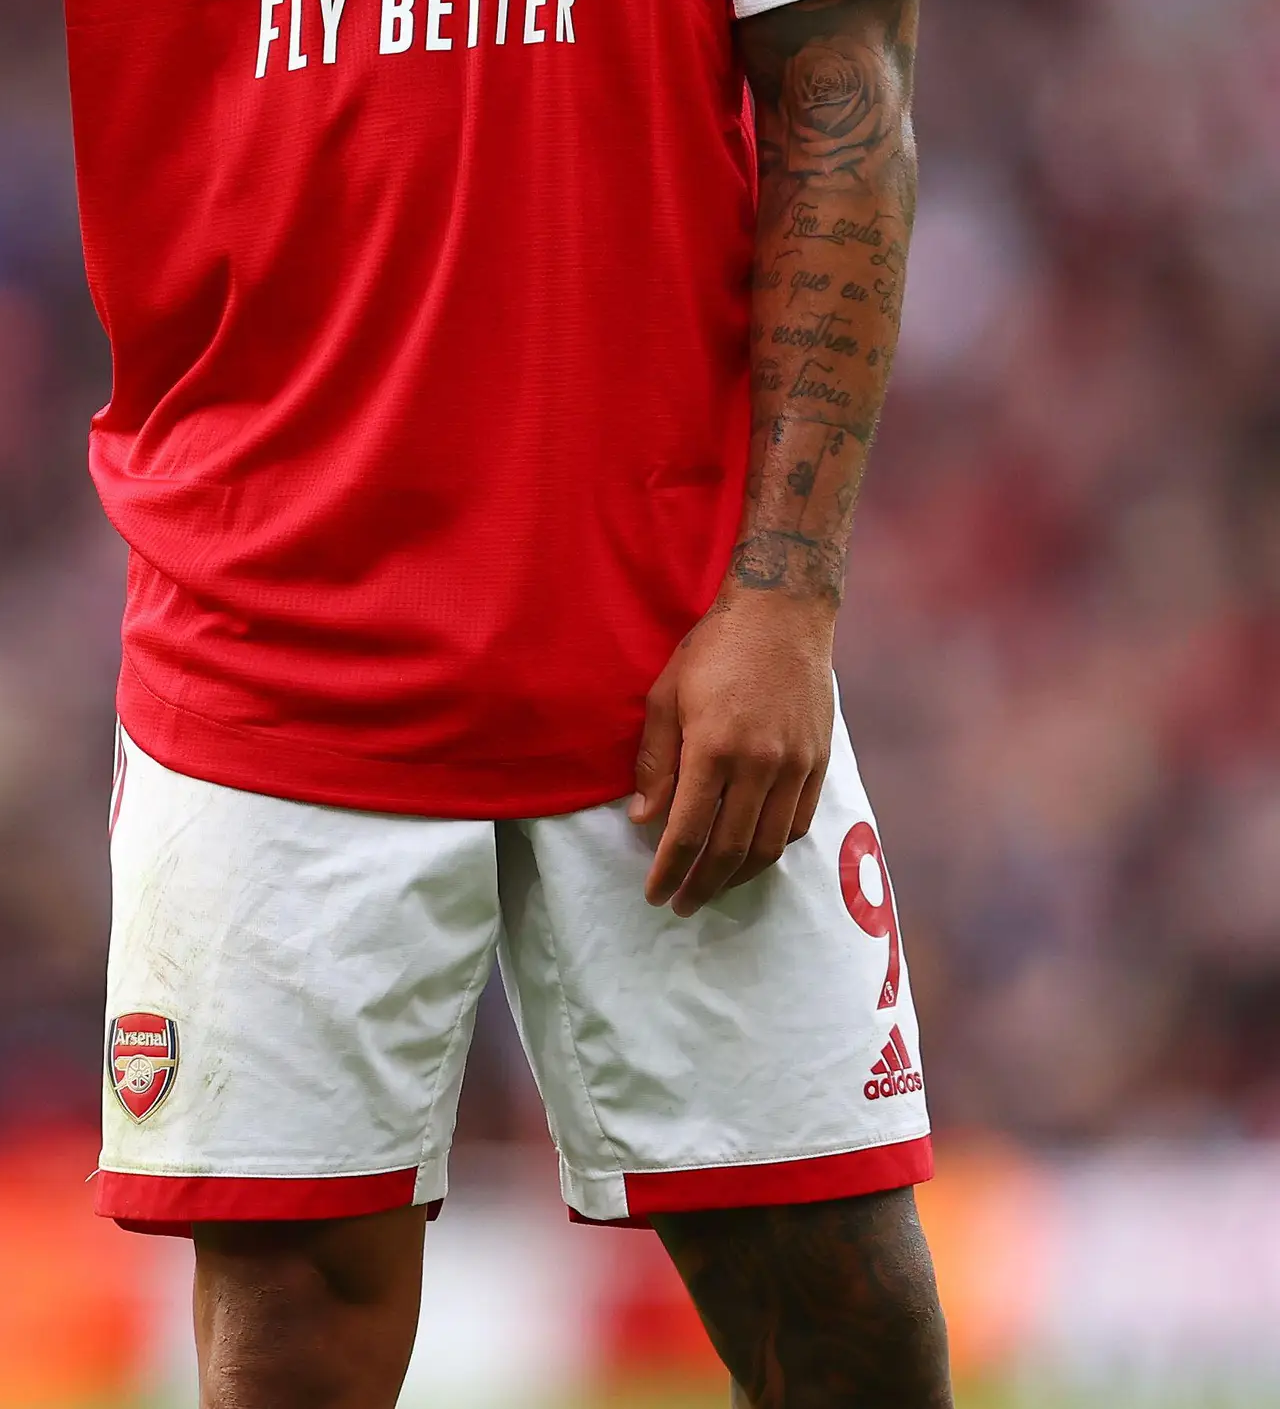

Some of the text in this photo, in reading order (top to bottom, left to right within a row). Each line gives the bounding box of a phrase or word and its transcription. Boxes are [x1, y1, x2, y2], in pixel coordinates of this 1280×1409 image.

[838, 821, 901, 1011] 9
[114, 1027, 168, 1047] Arsenal
[863, 1071, 923, 1100] adidas
